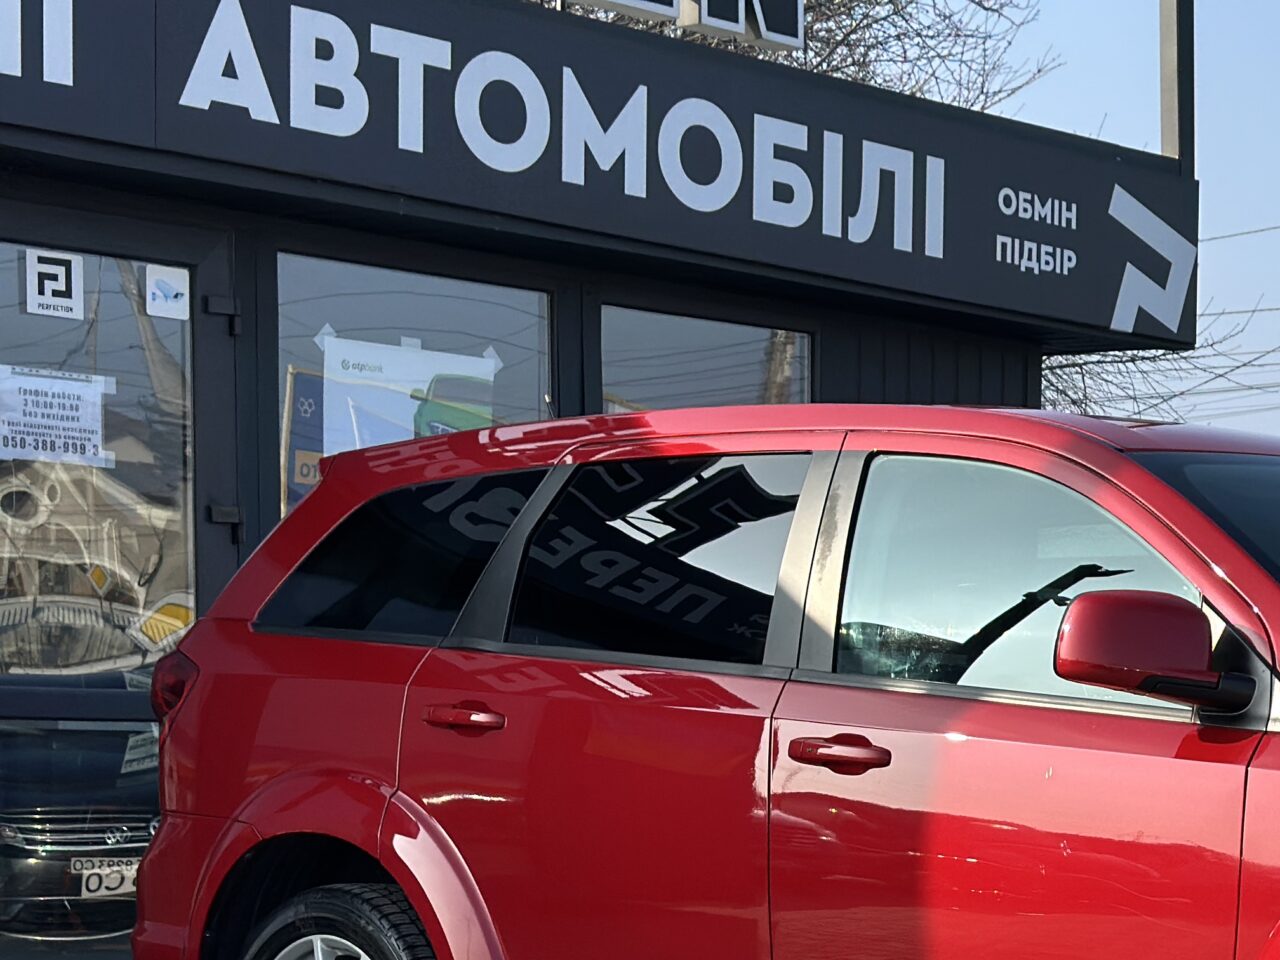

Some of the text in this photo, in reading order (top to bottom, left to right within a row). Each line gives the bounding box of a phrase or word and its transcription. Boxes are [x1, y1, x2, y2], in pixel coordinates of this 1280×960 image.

[178, 0, 944, 258] АВТОМОБІЛІ
[998, 187, 1077, 230] ОБМІН
[996, 234, 1077, 275] ПІДБІР
[38, 302, 74, 313] PERFECTION
[2, 435, 99, 457] 050-388-999-3
